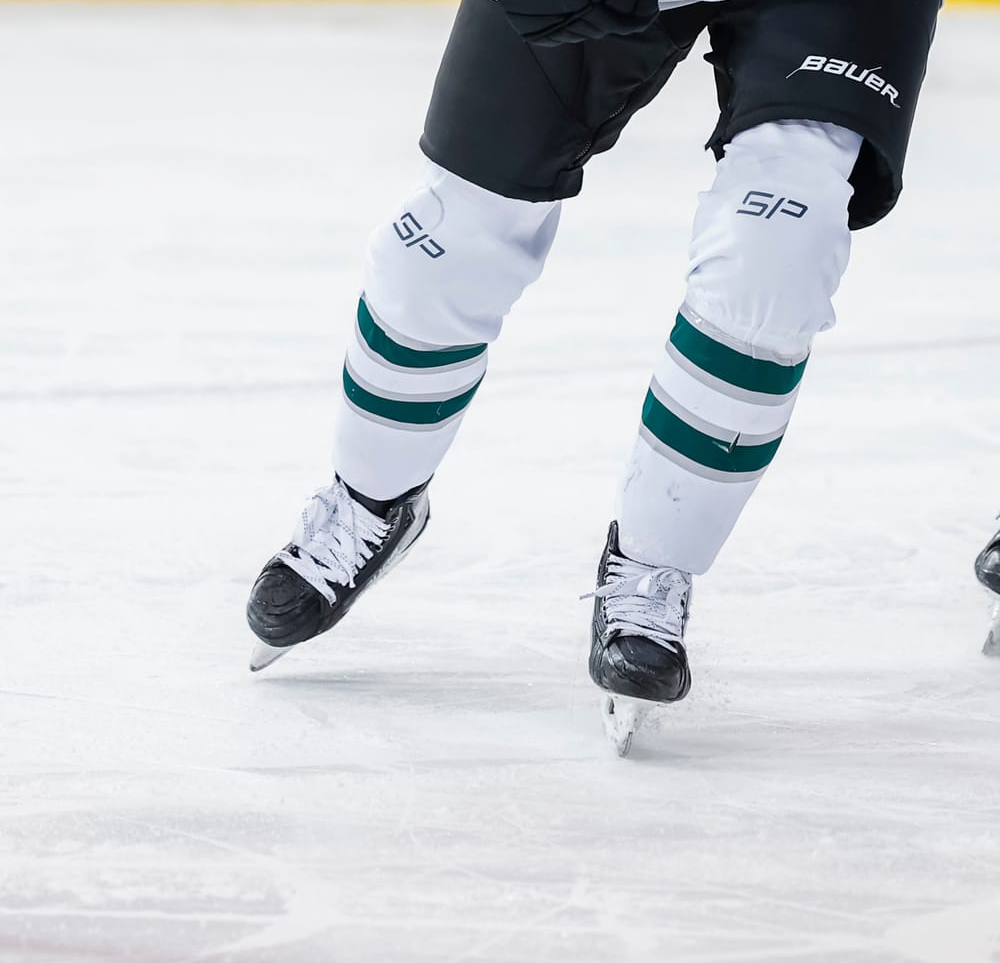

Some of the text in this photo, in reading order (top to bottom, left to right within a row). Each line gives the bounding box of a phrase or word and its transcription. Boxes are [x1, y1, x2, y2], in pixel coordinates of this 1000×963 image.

[799, 54, 901, 108] BAUER
[736, 190, 808, 220] SP
[392, 212, 446, 260] SP
